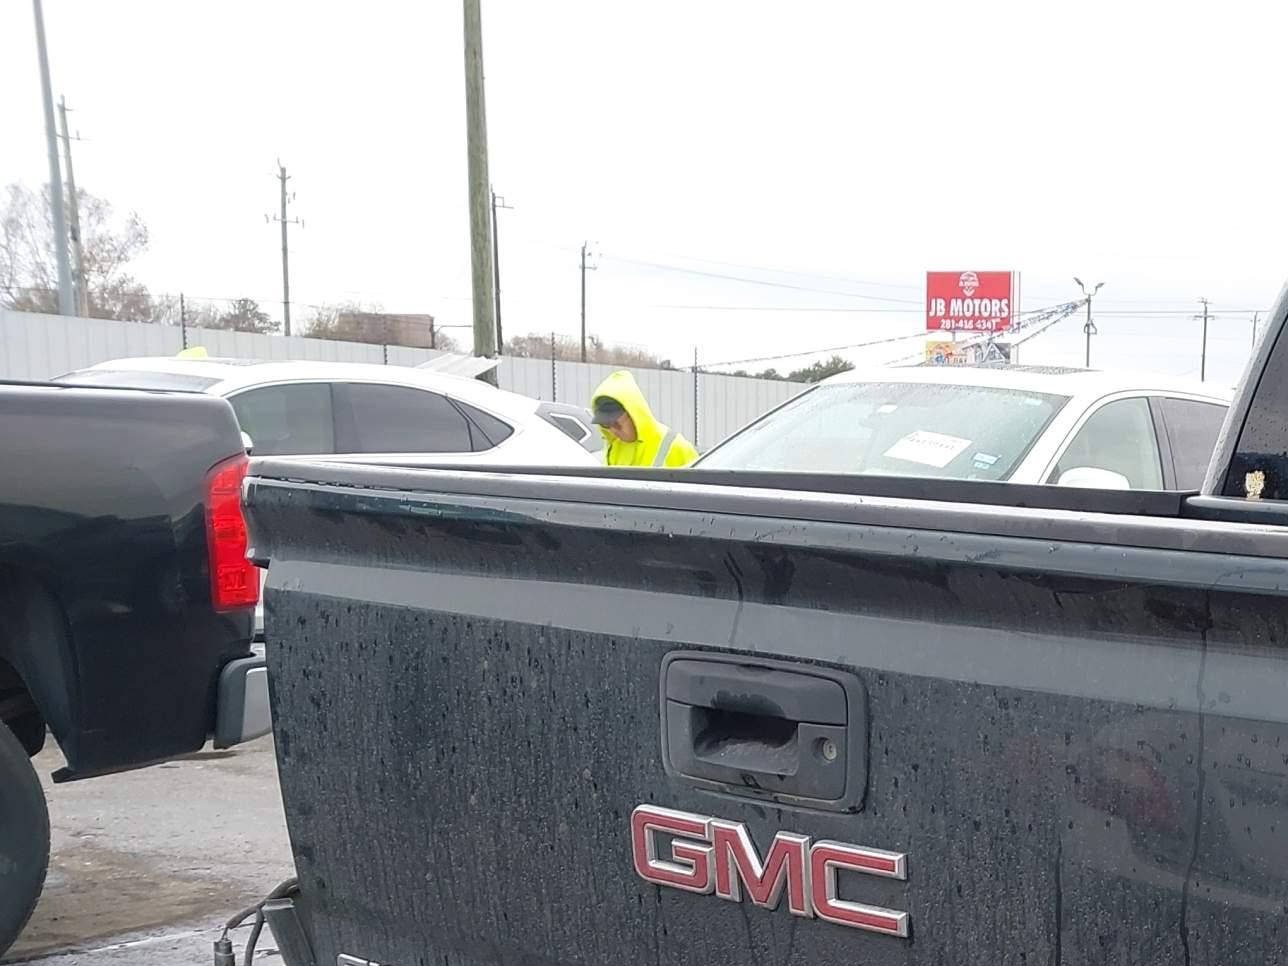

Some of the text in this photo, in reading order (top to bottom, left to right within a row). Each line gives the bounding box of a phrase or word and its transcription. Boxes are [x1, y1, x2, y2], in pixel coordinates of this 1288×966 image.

[929, 299, 1009, 317] JB MOTORS
[631, 804, 909, 938] GMC
